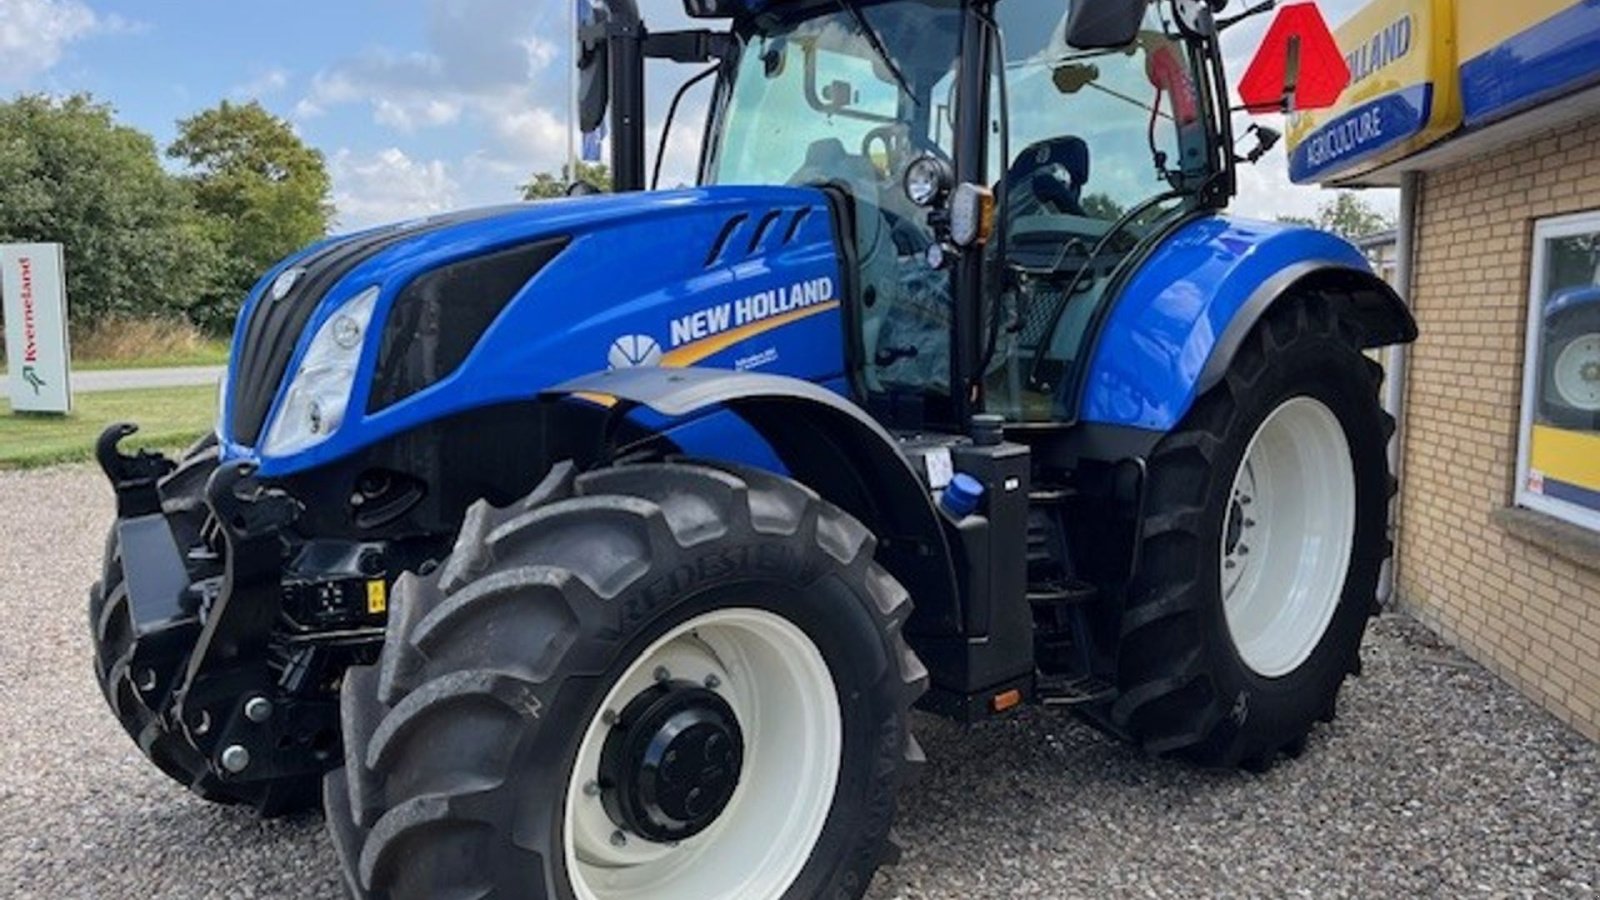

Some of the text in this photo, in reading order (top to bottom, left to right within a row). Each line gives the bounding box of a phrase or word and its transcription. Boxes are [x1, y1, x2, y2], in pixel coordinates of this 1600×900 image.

[1306, 106, 1382, 168] AGRICULTURE
[18, 257, 36, 362] Kverneland
[671, 276, 832, 346] NEW HOLLAND
